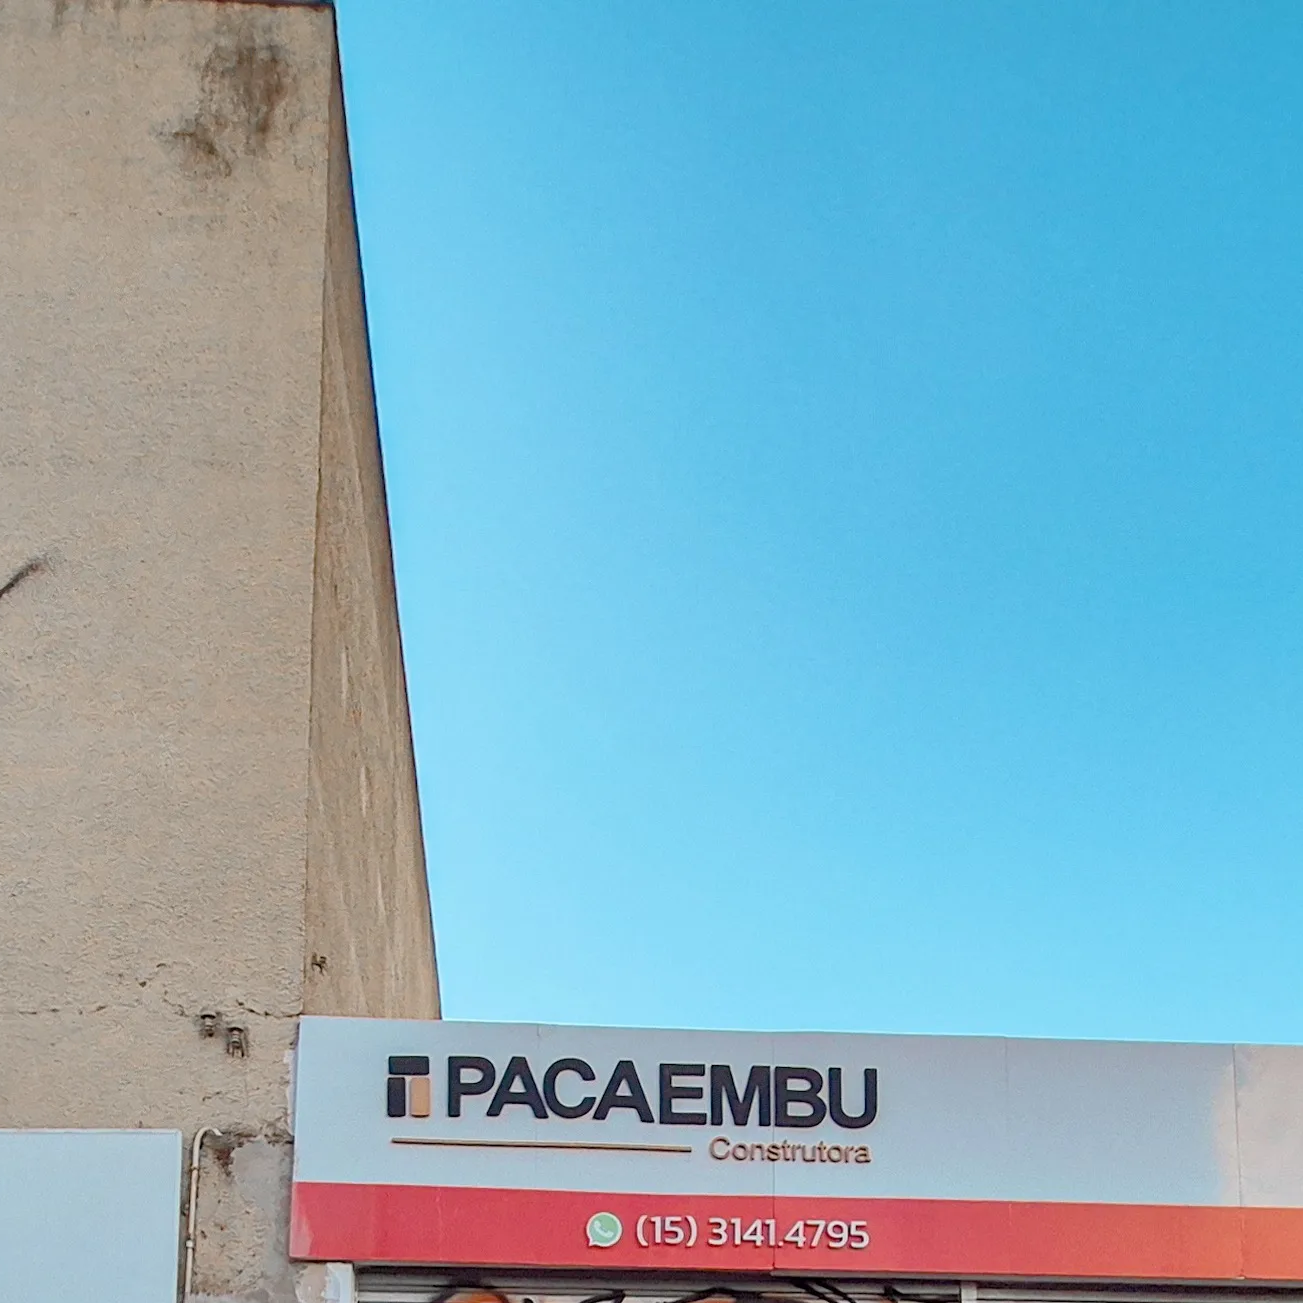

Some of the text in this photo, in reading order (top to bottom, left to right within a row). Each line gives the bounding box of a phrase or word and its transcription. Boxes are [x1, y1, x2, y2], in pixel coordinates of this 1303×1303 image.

[447, 1055, 878, 1129] PACAEMBU
[709, 1136, 872, 1164] Construtora
[635, 1214, 871, 1250] (15) 3141.4795
